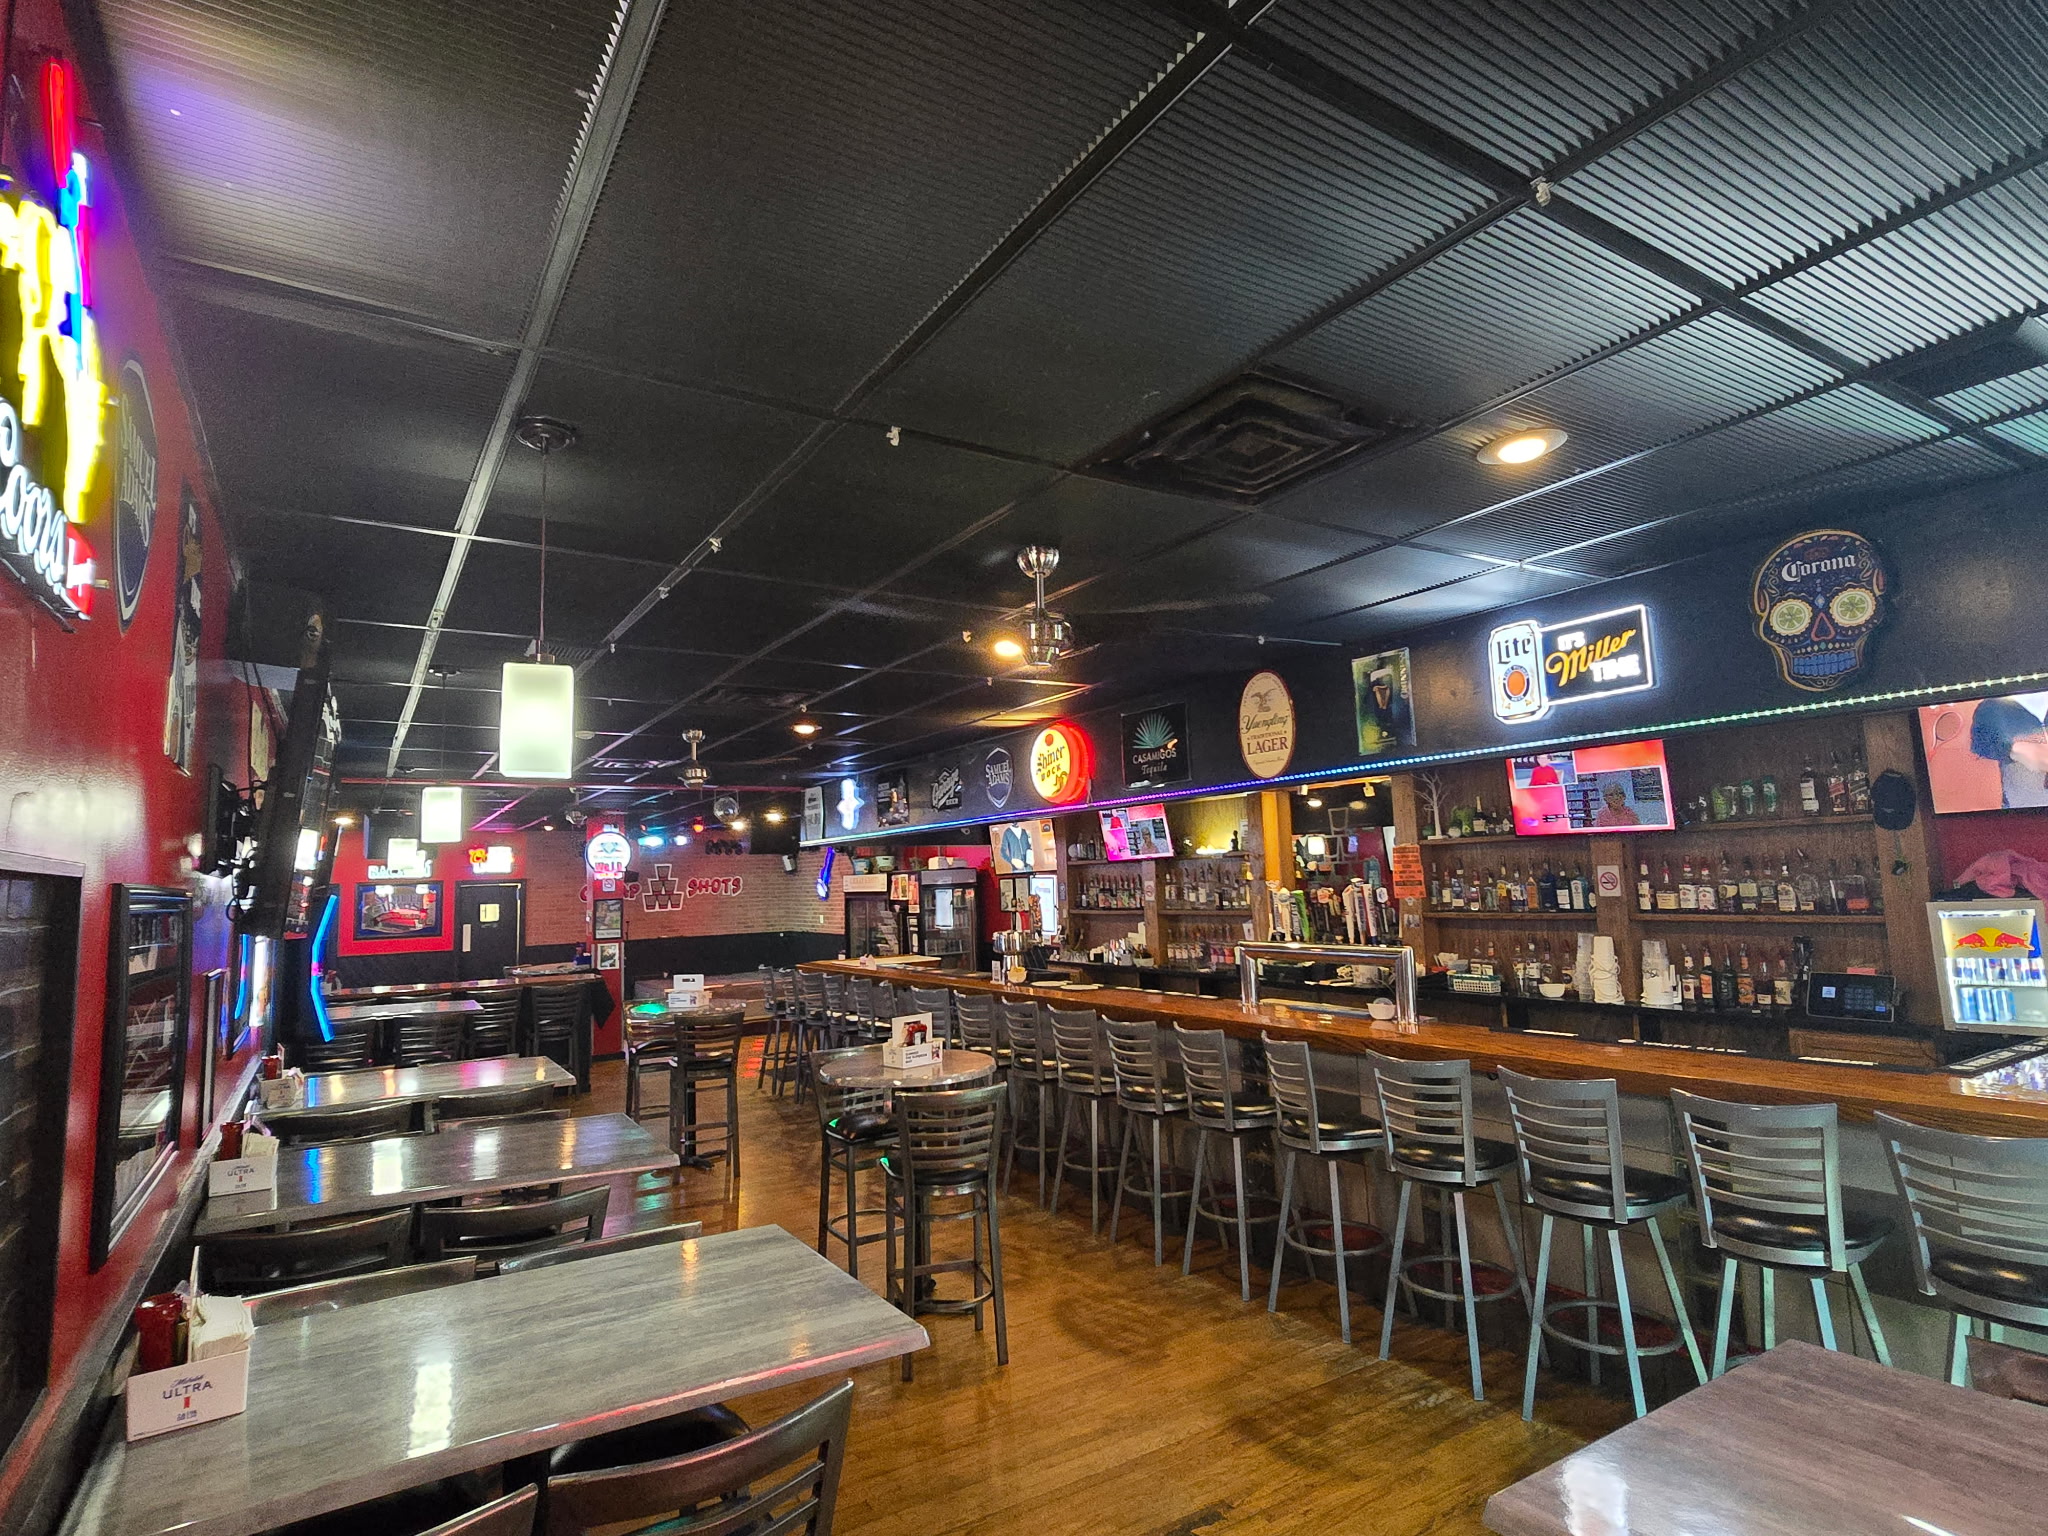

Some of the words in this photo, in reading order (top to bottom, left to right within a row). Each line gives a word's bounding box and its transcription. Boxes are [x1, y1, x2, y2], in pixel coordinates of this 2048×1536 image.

[121, 394, 156, 511] SAMUEL
[119, 456, 150, 548] ADAMS
[1781, 554, 1857, 582] Corona
[1496, 636, 1531, 665] Lite
[1545, 628, 1637, 687] Miller
[1588, 653, 1641, 683] TIME
[1240, 713, 1290, 735] Yuengling
[1250, 730, 1283, 740] TRADITIONAL
[1132, 748, 1177, 765] CASAMIGOS
[1247, 736, 1288, 756] LAGER
[985, 760, 1012, 777] SAMUEL
[1036, 746, 1066, 776] Shiner
[1141, 762, 1168, 777] Tequila
[986, 772, 1011, 788] ADAMS
[686, 876, 743, 899] SHOTS
[227, 1167, 255, 1177] ULTRA
[162, 1380, 213, 1400] ULTRA
